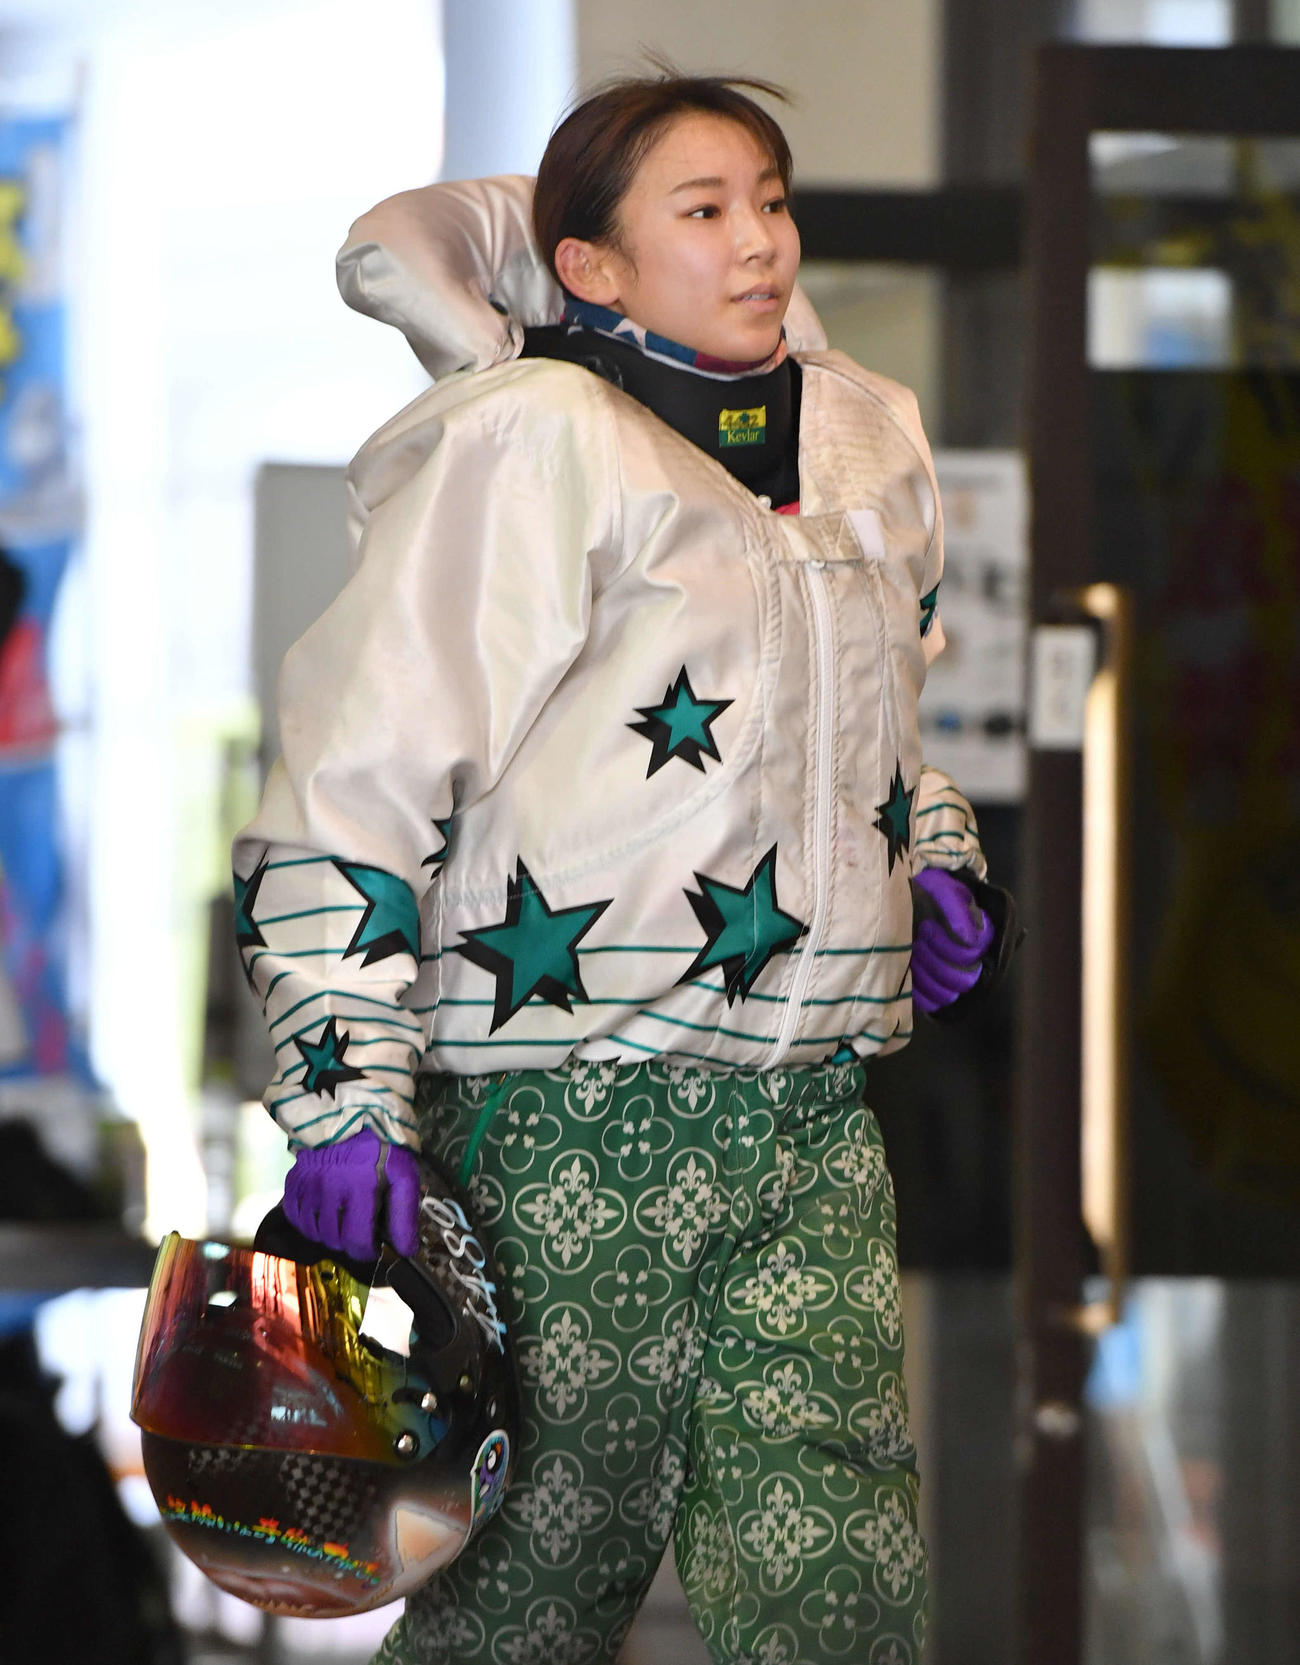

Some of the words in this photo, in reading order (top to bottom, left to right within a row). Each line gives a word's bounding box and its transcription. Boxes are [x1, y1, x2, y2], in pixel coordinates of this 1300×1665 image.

[727, 428, 759, 443] Kevlar
[562, 1205, 578, 1220] M
[682, 1203, 696, 1218] S
[772, 1284, 787, 1296] M
[555, 1357, 571, 1371] M
[550, 1503, 565, 1516] M
[774, 1528, 788, 1541] M
